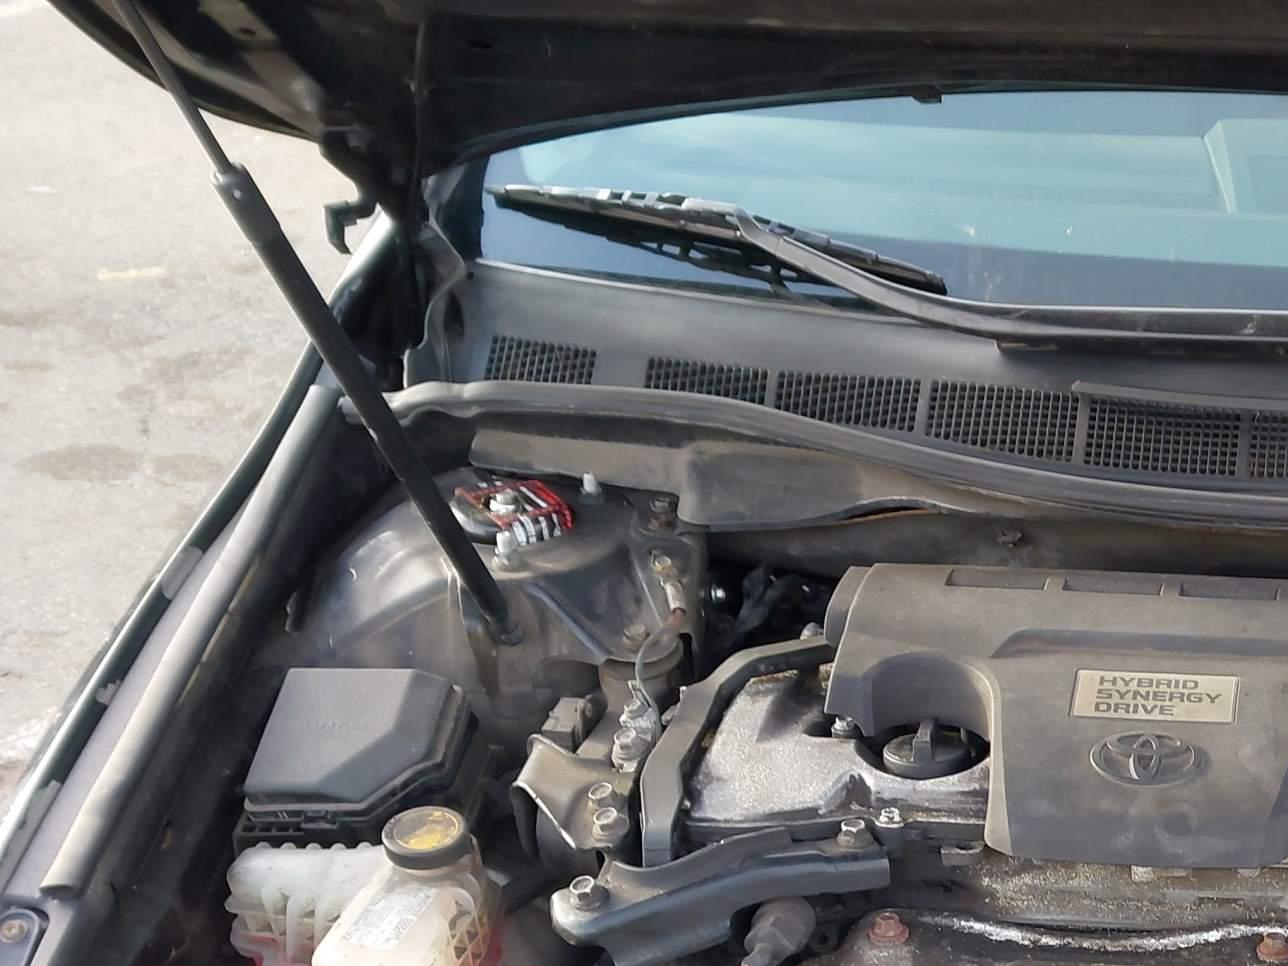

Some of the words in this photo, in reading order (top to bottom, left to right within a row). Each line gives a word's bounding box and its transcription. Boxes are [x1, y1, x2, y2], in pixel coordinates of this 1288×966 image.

[1098, 676, 1199, 690] HYBRID
[1095, 688, 1222, 704] SYNERGY
[1093, 701, 1176, 716] DRIVE
